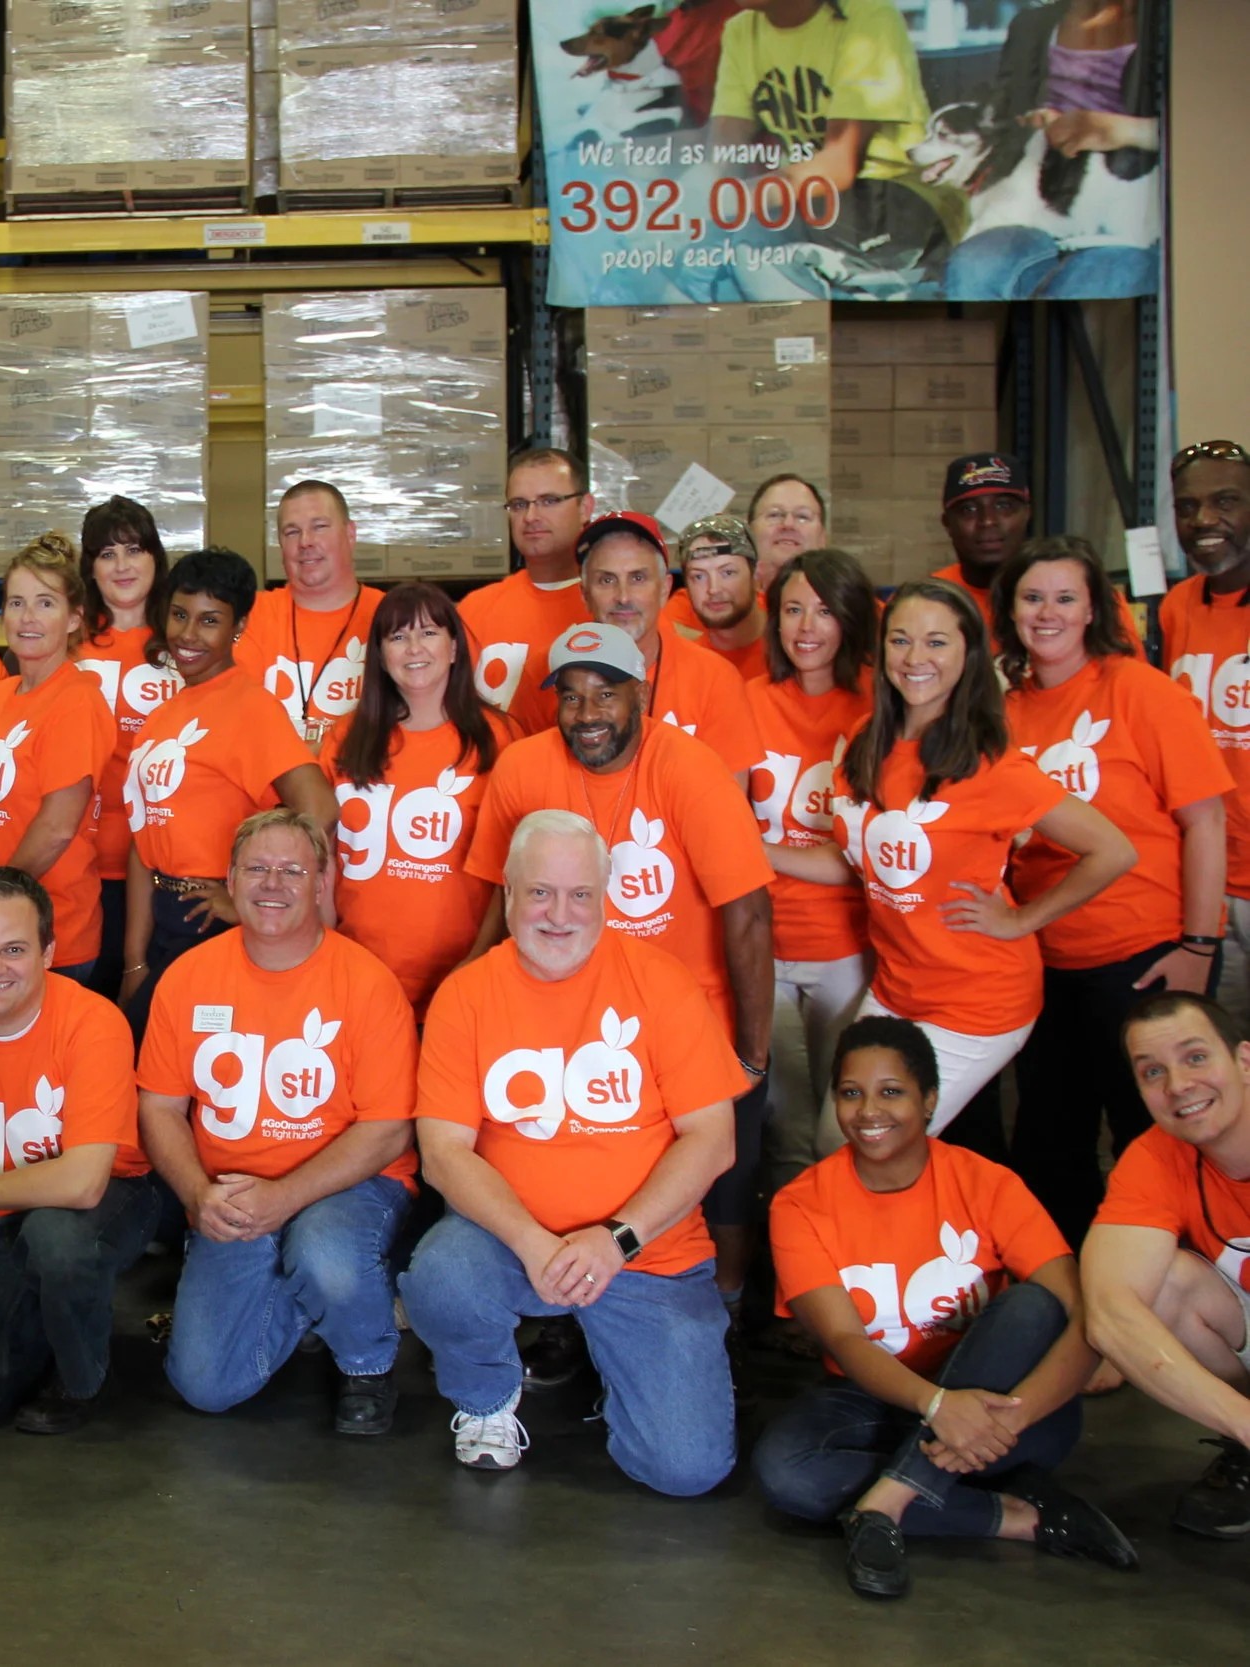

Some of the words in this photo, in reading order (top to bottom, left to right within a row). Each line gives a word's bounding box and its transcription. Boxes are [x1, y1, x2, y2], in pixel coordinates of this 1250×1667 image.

[579, 141, 613, 166] We
[624, 137, 671, 166] feed
[680, 146, 704, 164] as
[713, 142, 779, 169] many
[789, 142, 815, 163] as
[560, 175, 839, 240] 392,000
[602, 245, 675, 274] people
[685, 239, 736, 267] each
[746, 245, 798, 272] year
[566, 630, 602, 652] C
[140, 679, 178, 701] stl
[327, 675, 362, 701] stl
[1224, 679, 1250, 708] st
[145, 758, 174, 787] stl
[806, 788, 833, 816] st
[408, 811, 451, 843] stl
[387, 858, 453, 874] #GoOrangeSTL
[878, 840, 917, 871] stl
[620, 865, 664, 899] stl
[281, 1067, 322, 1099] stl
[586, 1068, 631, 1105] stl
[261, 1117, 325, 1130] #GoOrangeSTL
[262, 1129, 270, 1137] to
[271, 1130, 291, 1140] fight
[293, 1129, 323, 1140] hunger
[22, 1134, 63, 1164] stl
[931, 1283, 980, 1320] stl
